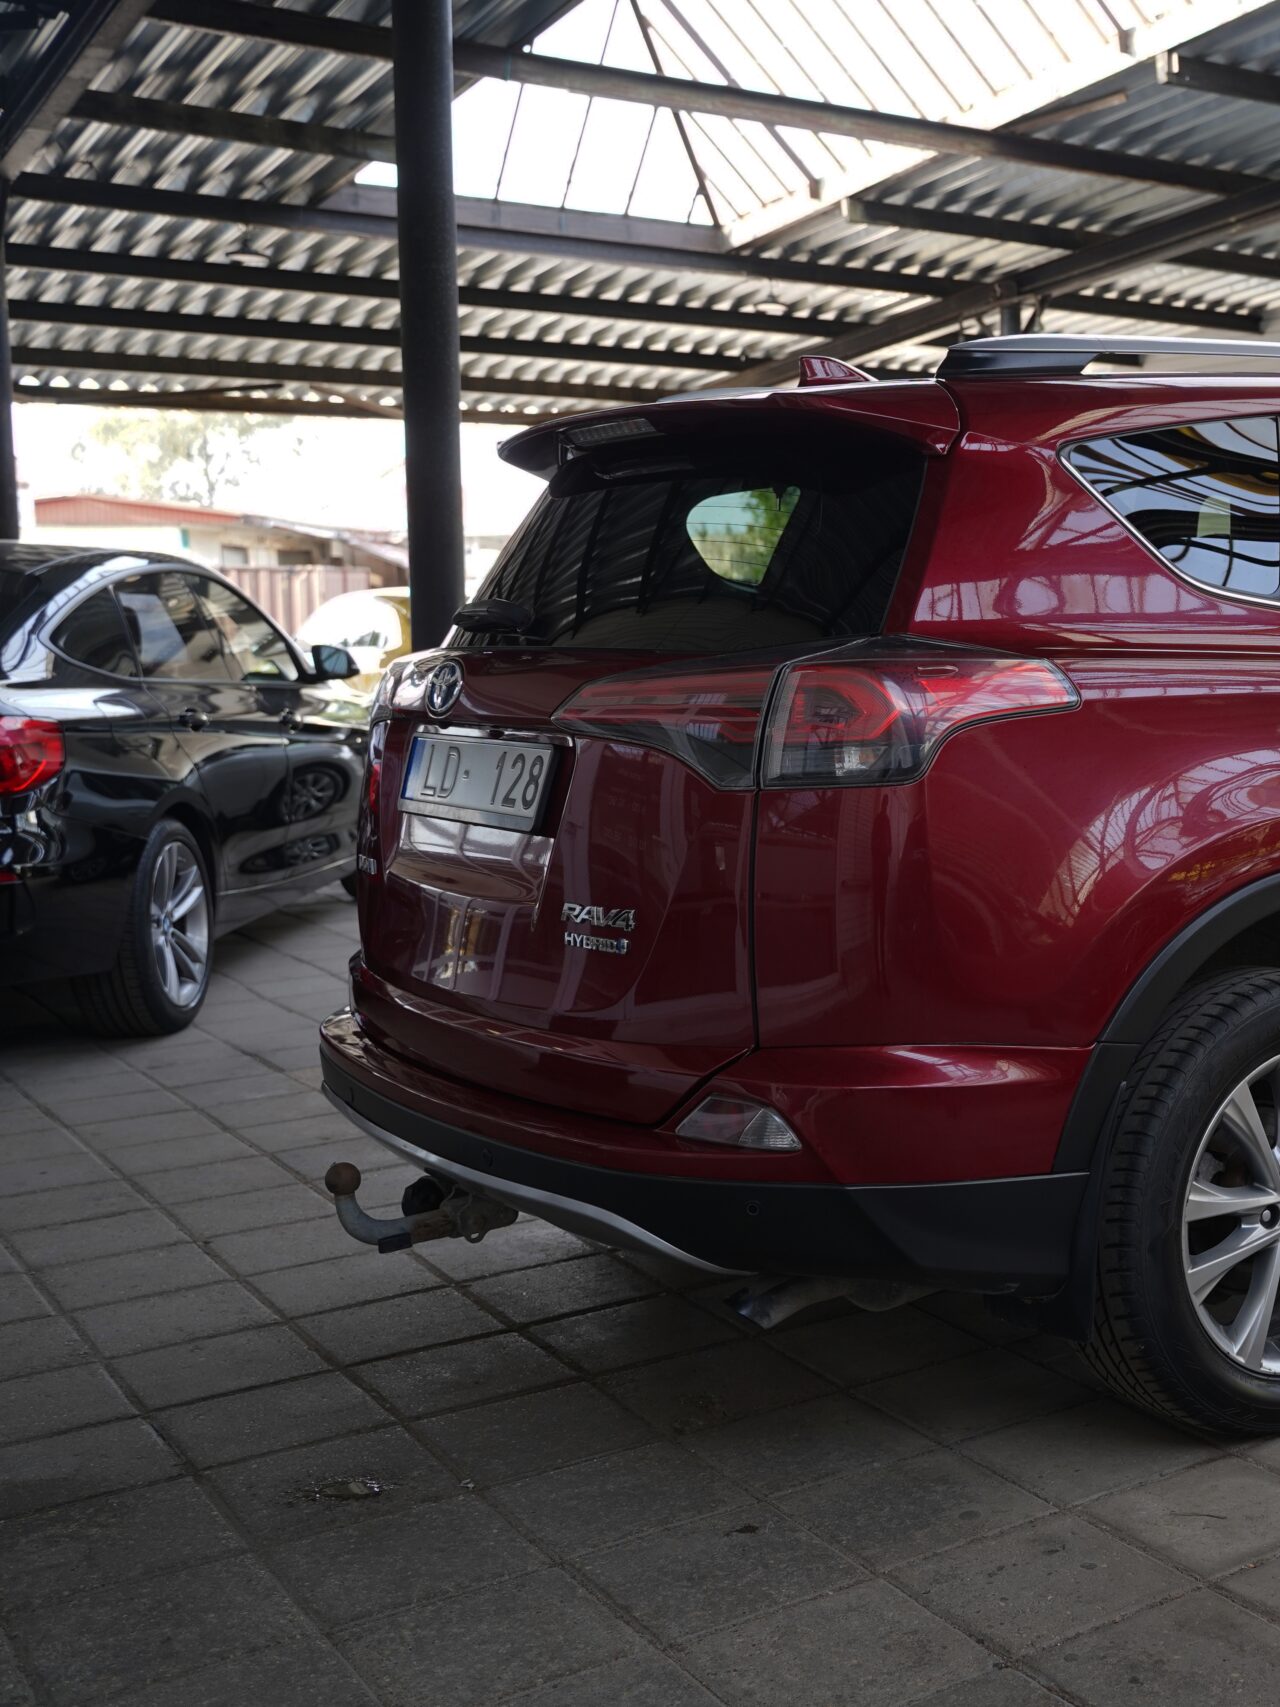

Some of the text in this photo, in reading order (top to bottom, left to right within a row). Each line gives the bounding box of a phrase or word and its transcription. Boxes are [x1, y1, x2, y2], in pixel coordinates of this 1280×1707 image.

[490, 751, 544, 810] 128
[560, 902, 636, 932] RAV4
[564, 931, 618, 953] HYBRID
